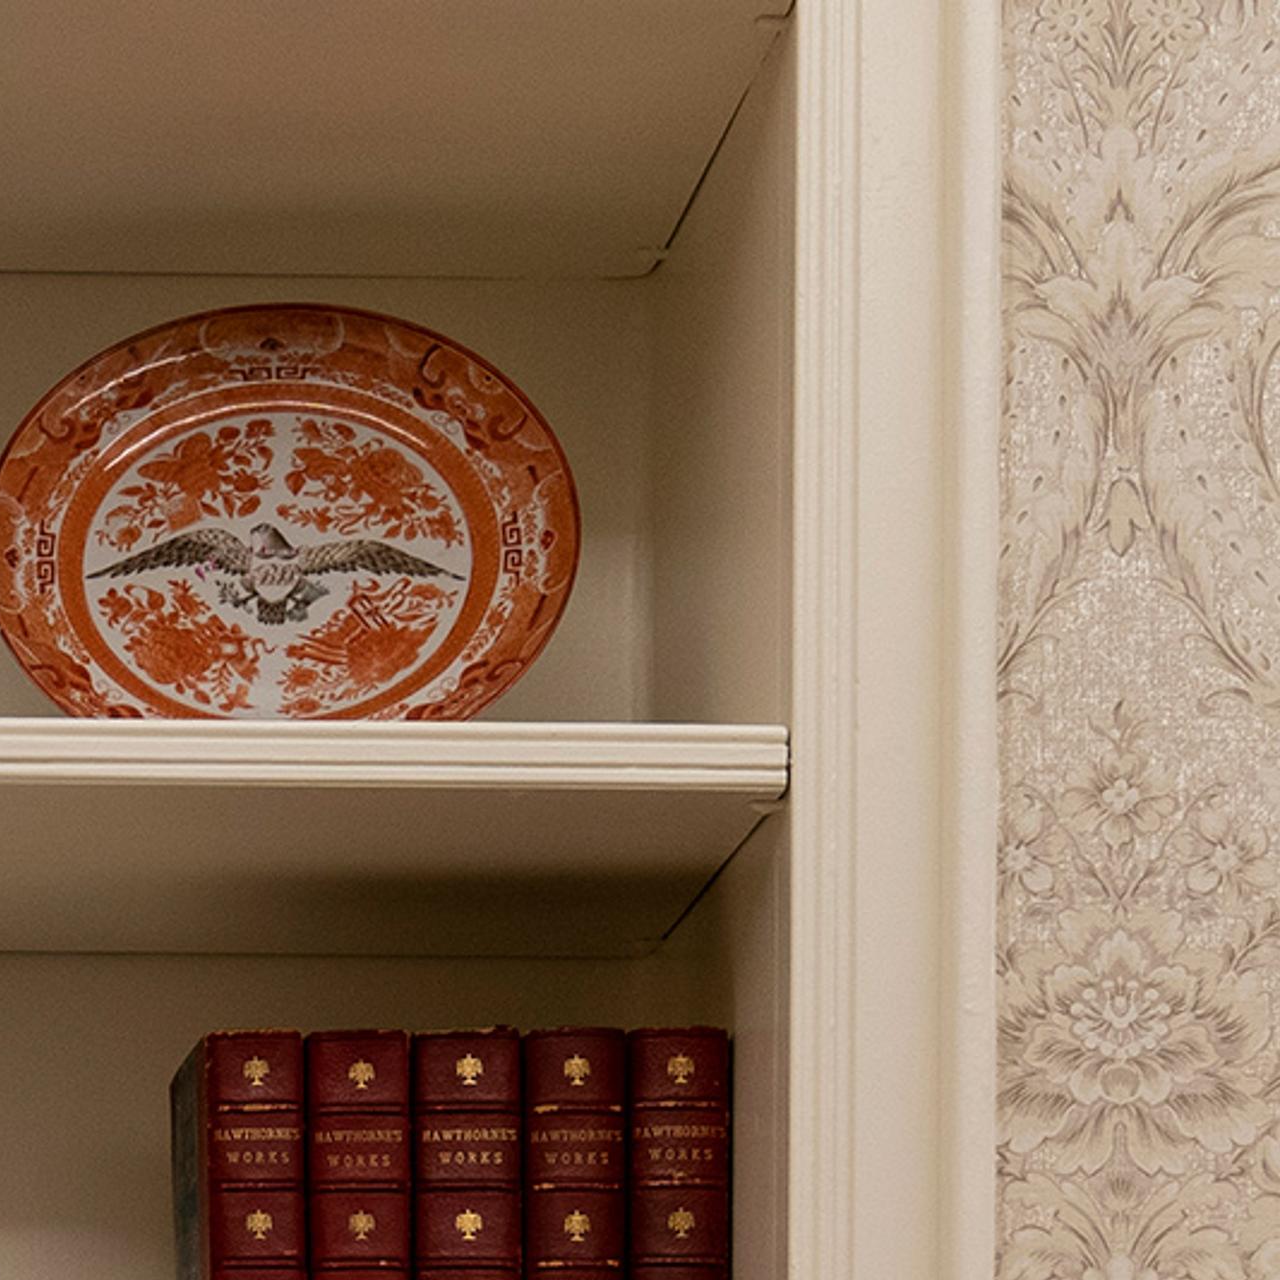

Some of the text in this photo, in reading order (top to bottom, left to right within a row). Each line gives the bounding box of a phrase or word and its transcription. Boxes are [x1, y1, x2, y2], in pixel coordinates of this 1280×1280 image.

[226, 1150, 290, 1164] WORKS
[438, 1151, 503, 1165] WORKS
[544, 1151, 609, 1165] WORKS
[647, 1147, 713, 1161] WORKS
[326, 1153, 391, 1171] WORKS
